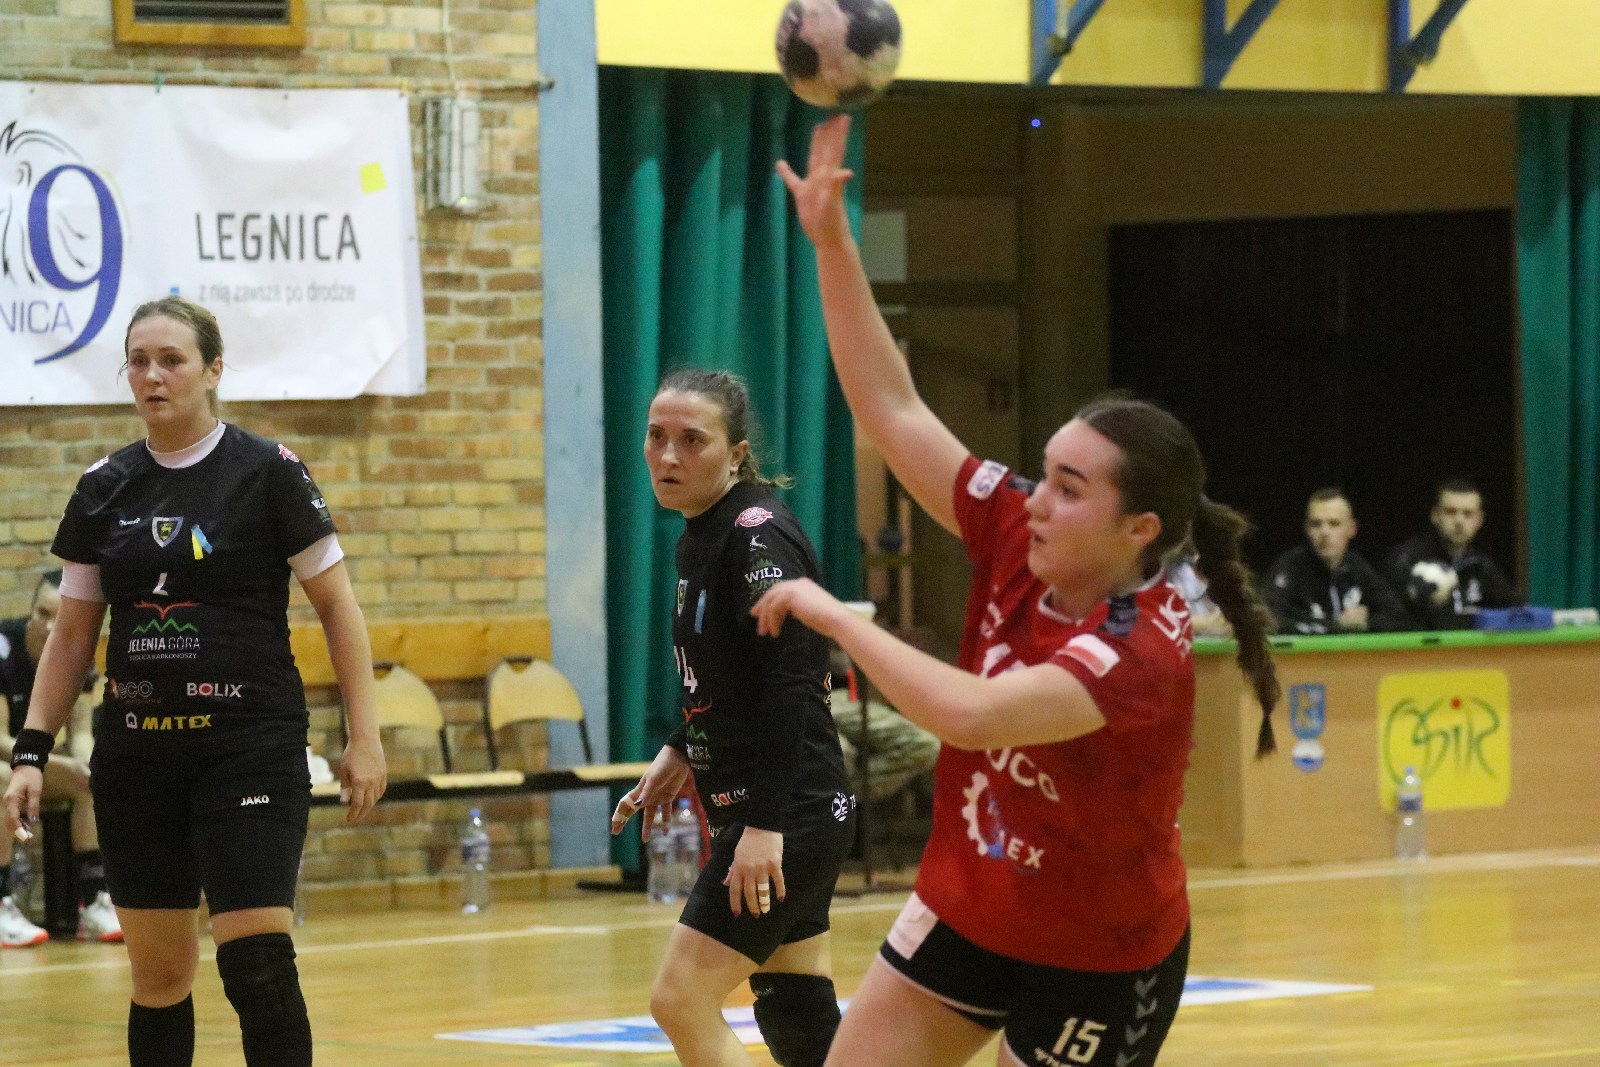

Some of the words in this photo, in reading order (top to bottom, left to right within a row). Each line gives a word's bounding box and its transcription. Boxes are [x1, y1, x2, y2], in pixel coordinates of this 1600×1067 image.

[196, 212, 361, 262] LEGNICA
[744, 566, 783, 584] WILD
[127, 637, 166, 653] JELENIA
[168, 635, 200, 651] GÓRA
[186, 682, 243, 698] BOLIX
[142, 714, 212, 730] MATEX
[240, 795, 270, 806] JAKO
[1052, 1017, 1107, 1064] 15
